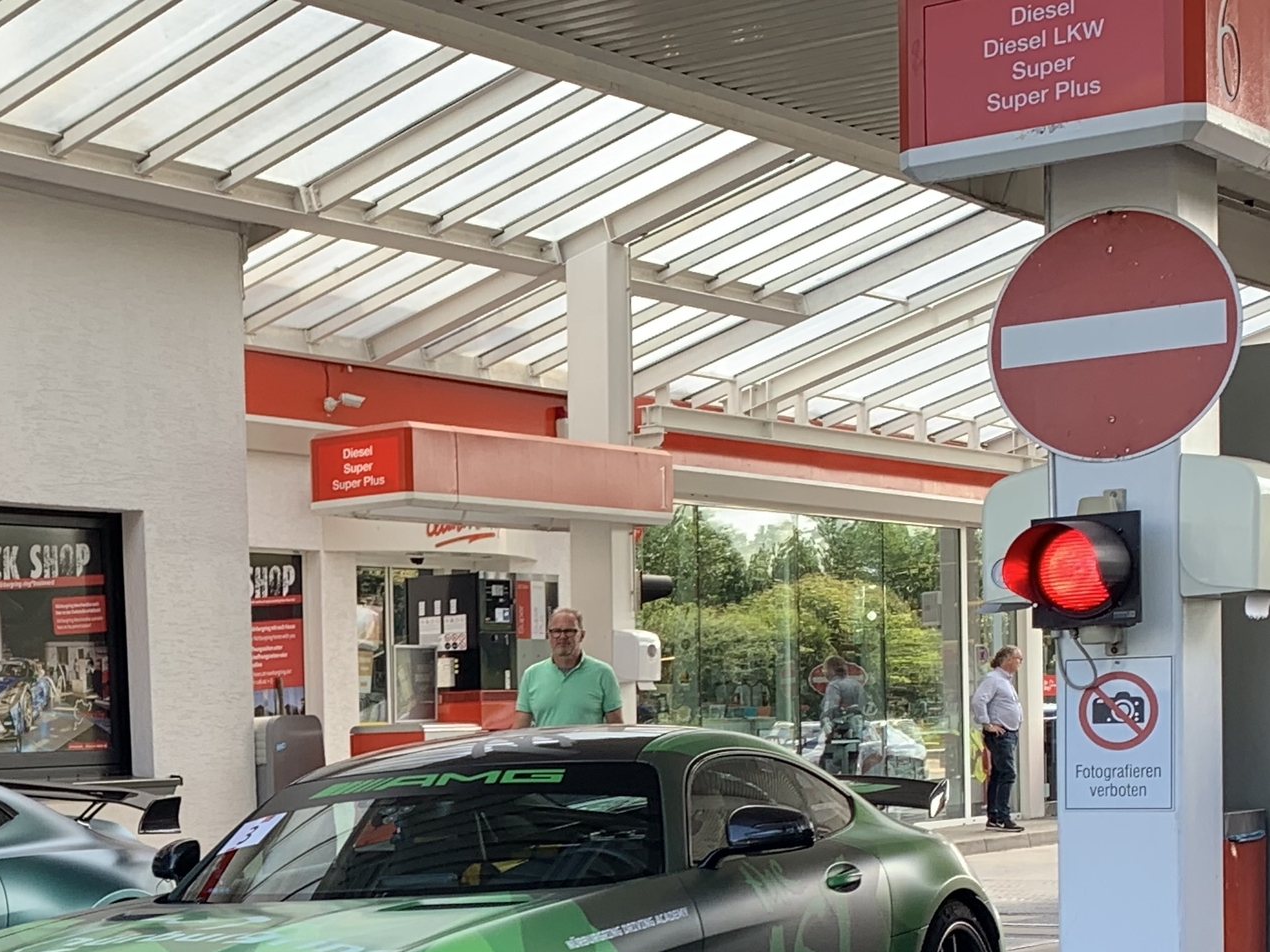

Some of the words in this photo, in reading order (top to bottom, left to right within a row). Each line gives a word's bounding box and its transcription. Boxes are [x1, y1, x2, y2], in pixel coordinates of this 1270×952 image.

[1011, 0, 1075, 26] Diesel
[983, 30, 1046, 58] Diesel
[1053, 18, 1105, 46] LKW
[1217, 0, 1241, 102] 6
[1011, 55, 1075, 81] Super
[986, 88, 1049, 112] Super
[1054, 79, 1102, 101] Plus
[342, 445, 374, 460] Diesel
[343, 461, 374, 475] Super
[332, 478, 362, 492] Super
[363, 475, 386, 487] Plus
[30, 543, 91, 580] SHOP
[370, 769, 566, 793] AMG
[1075, 764, 1162, 782] Fotografieren
[1090, 783, 1147, 797] verboten
